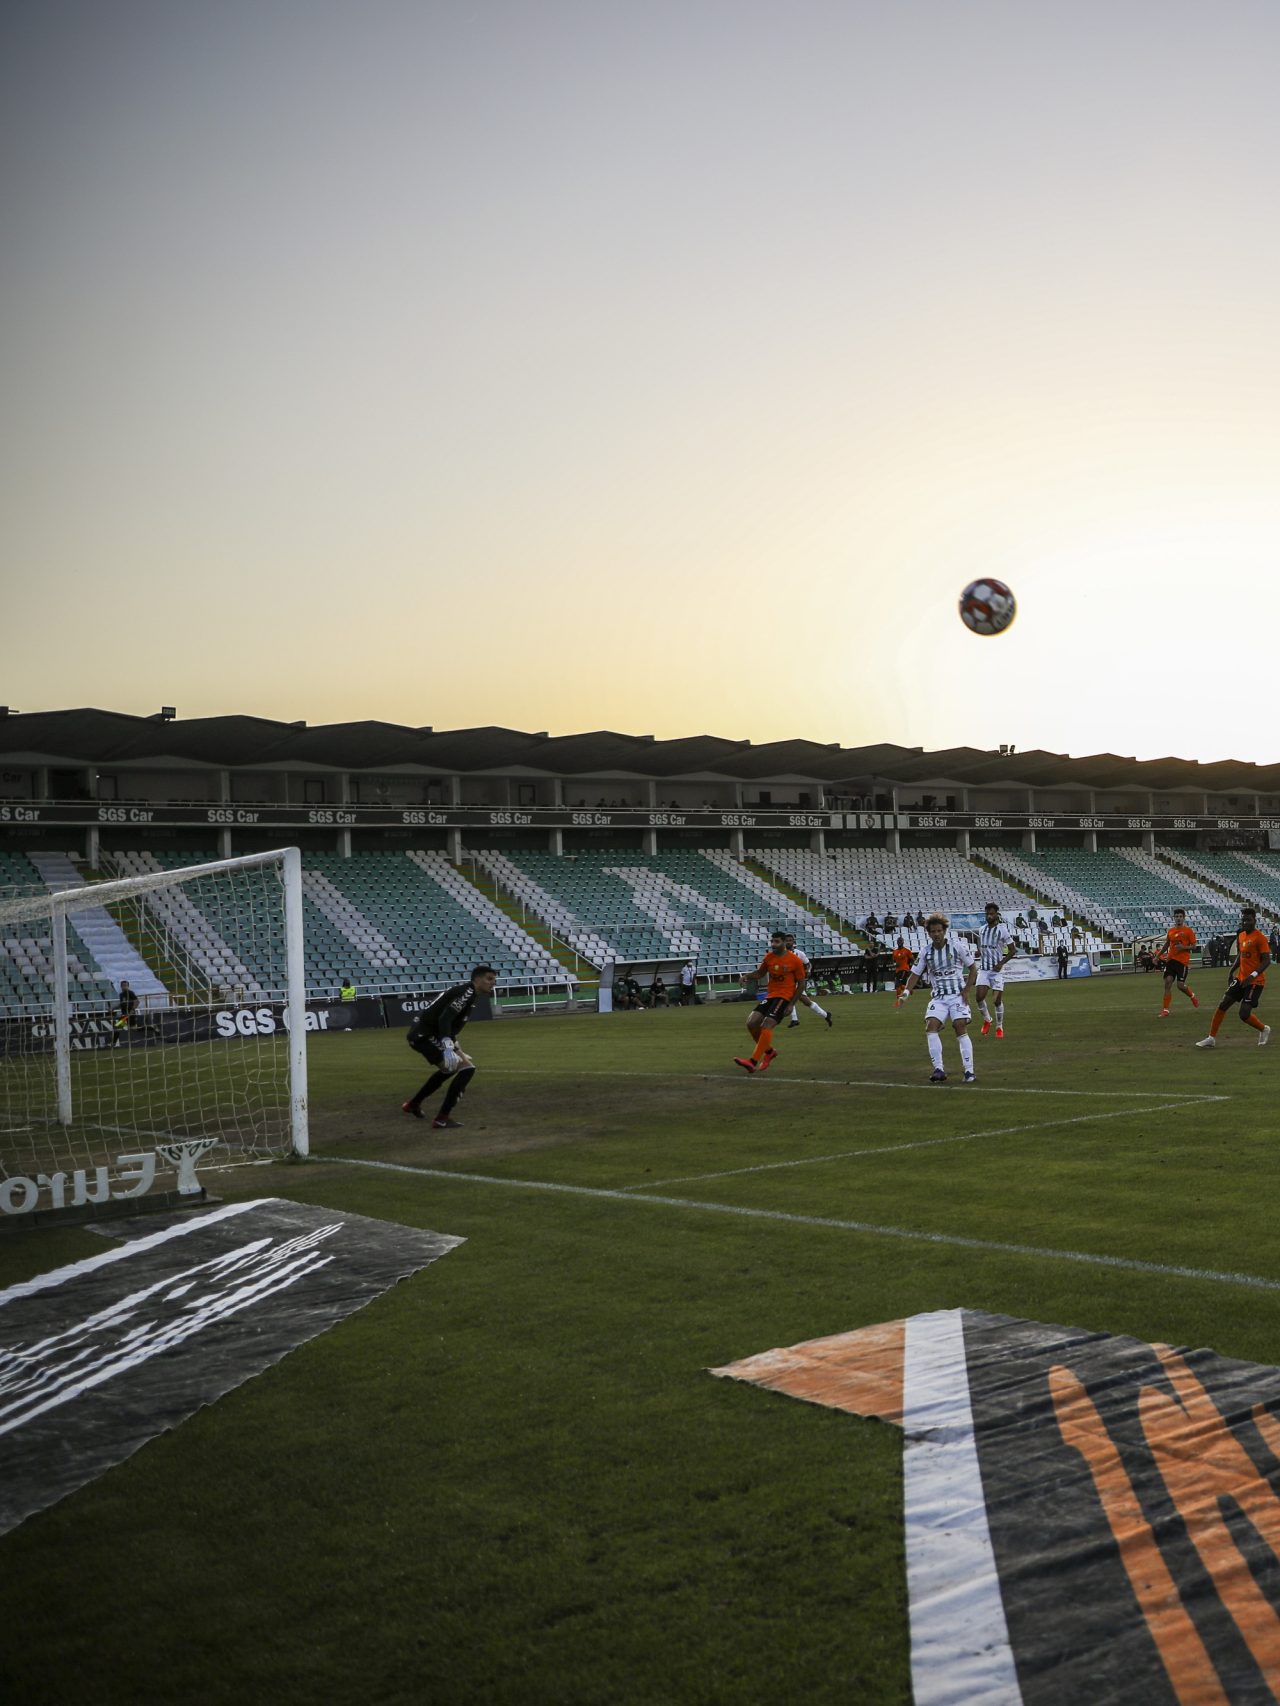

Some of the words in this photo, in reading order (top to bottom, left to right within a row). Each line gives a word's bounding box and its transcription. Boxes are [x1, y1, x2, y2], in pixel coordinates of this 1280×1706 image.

[14, 808, 40, 821] Car
[98, 809, 126, 822] SGS
[130, 809, 154, 822] Car
[208, 810, 234, 823] SGS
[237, 810, 259, 823] Car
[308, 811, 334, 824] SGS
[336, 811, 357, 824] Car
[402, 812, 426, 824] SGS
[428, 812, 448, 824] Car
[490, 813, 512, 824] SGS
[514, 813, 532, 824] Car
[572, 814, 592, 824] SGS
[595, 814, 612, 825] Car
[649, 814, 668, 825] SGS
[670, 815, 686, 826] Car
[215, 1008, 276, 1037] SGS
[283, 1006, 330, 1031] ar
